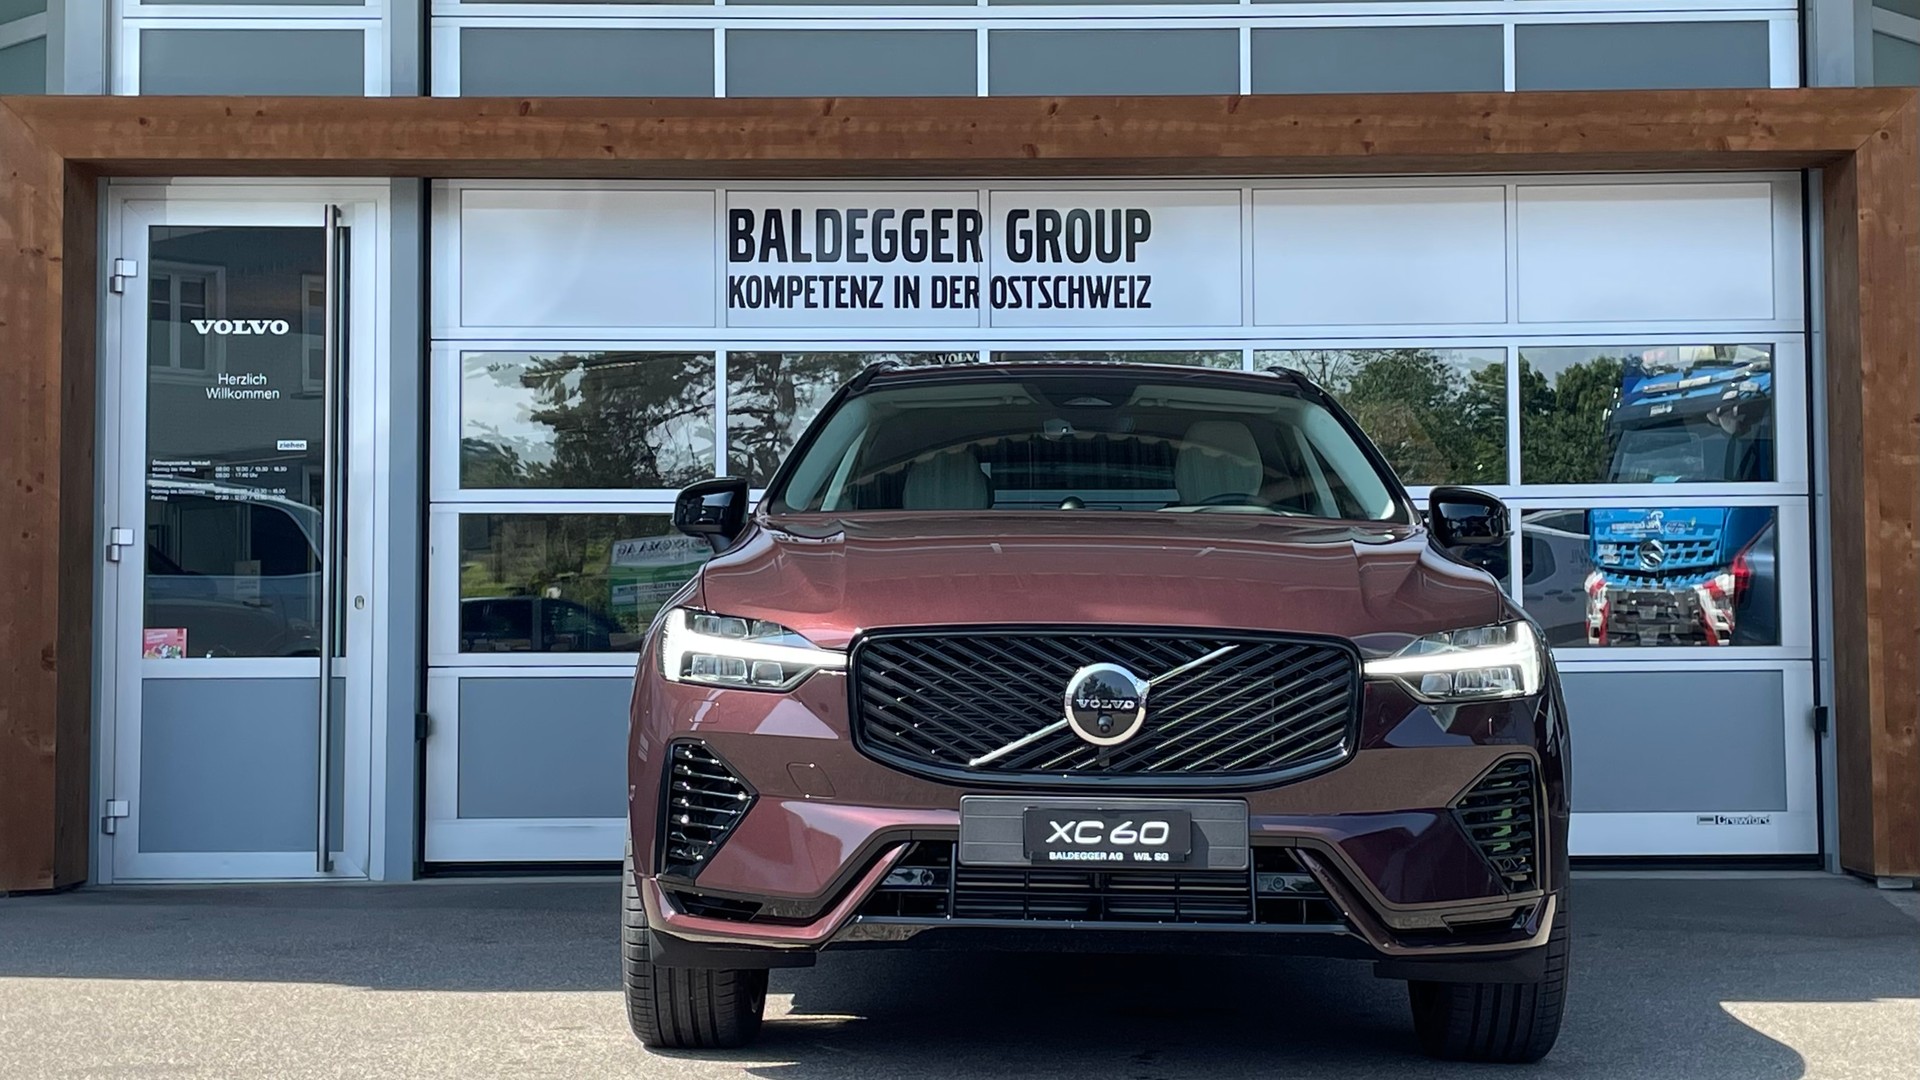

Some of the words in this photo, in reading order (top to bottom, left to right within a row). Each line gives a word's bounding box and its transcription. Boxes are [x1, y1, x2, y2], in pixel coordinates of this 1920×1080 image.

[728, 208, 983, 263] BALDEGGER
[1006, 208, 1152, 263] GROUP
[728, 275, 884, 309] KOMPETENZ
[894, 275, 920, 309] IN
[931, 275, 980, 309] DER
[990, 275, 1152, 309] OSTSCHWEIZ
[190, 319, 290, 335] VOLVO
[218, 373, 267, 386] Herzlich
[205, 388, 280, 400] Willkommen
[279, 441, 305, 449] ziehen
[1076, 699, 1135, 710] VOLVO
[1049, 852, 1107, 861] BALDEGGER
[1108, 852, 1124, 861] AG
[1133, 852, 1152, 861] WIL
[1154, 852, 1169, 861] SG
